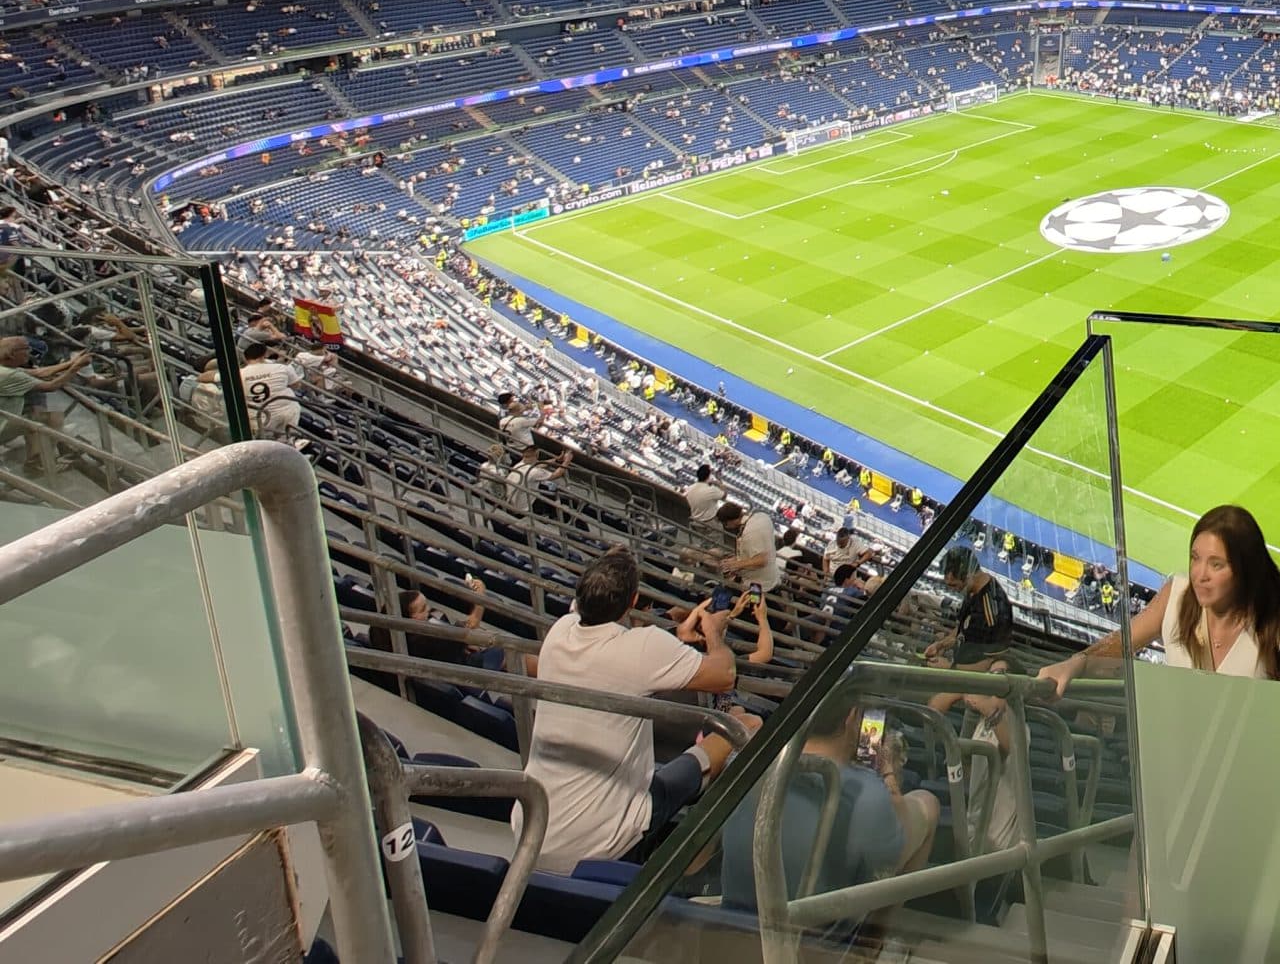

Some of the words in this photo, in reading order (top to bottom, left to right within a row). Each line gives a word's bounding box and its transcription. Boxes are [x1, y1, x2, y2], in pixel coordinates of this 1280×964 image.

[711, 153, 747, 171] PEPSI
[631, 173, 683, 194] Heineken
[564, 189, 622, 211] crypto.com
[250, 381, 270, 403] 9
[385, 828, 414, 855] 12
